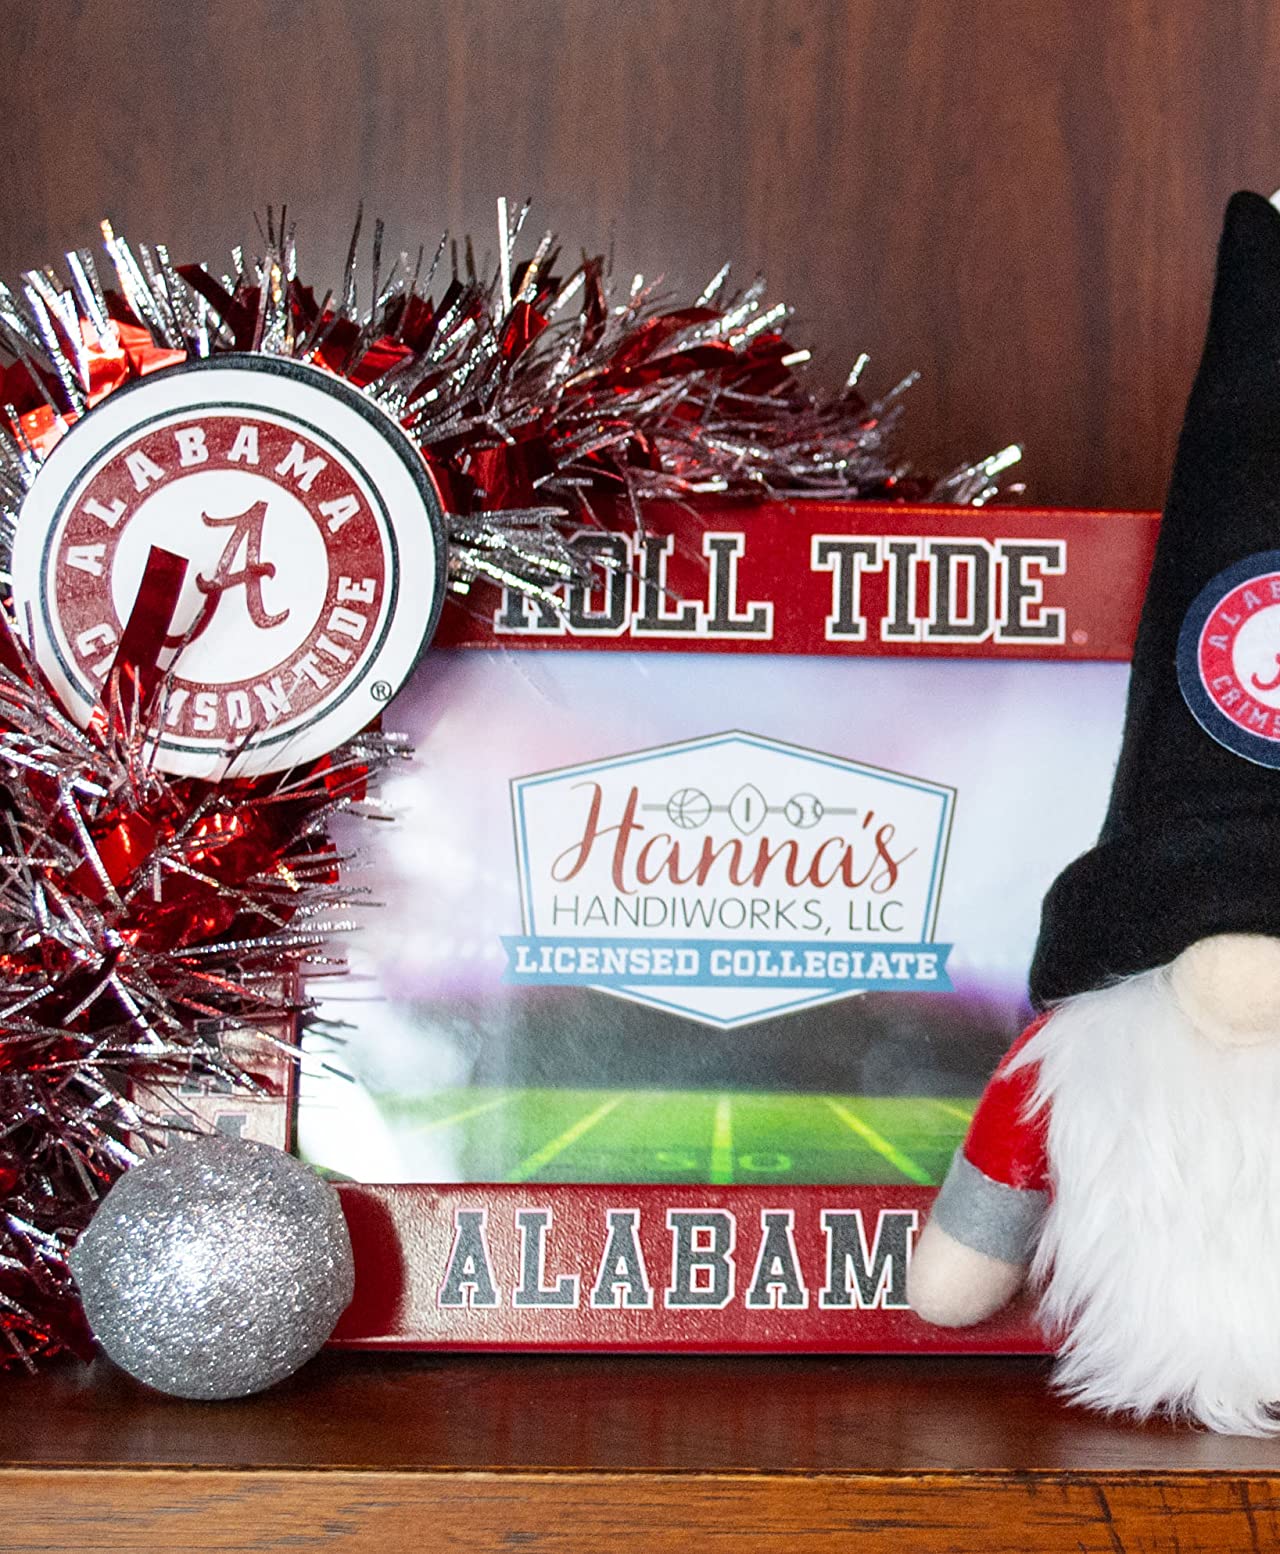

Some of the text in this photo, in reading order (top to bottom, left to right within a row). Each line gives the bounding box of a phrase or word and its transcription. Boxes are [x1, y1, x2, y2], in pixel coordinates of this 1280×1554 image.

[66, 425, 361, 578] ALABAMA
[812, 534, 1067, 644] TIDE
[75, 576, 376, 732] CMSON TIDE
[551, 782, 918, 895] Hanna's
[514, 945, 939, 980] LICENSED COLLEGIATE
[553, 895, 905, 935] HANDIWORKS, LLC
[437, 1208, 919, 1310] ALABAM
